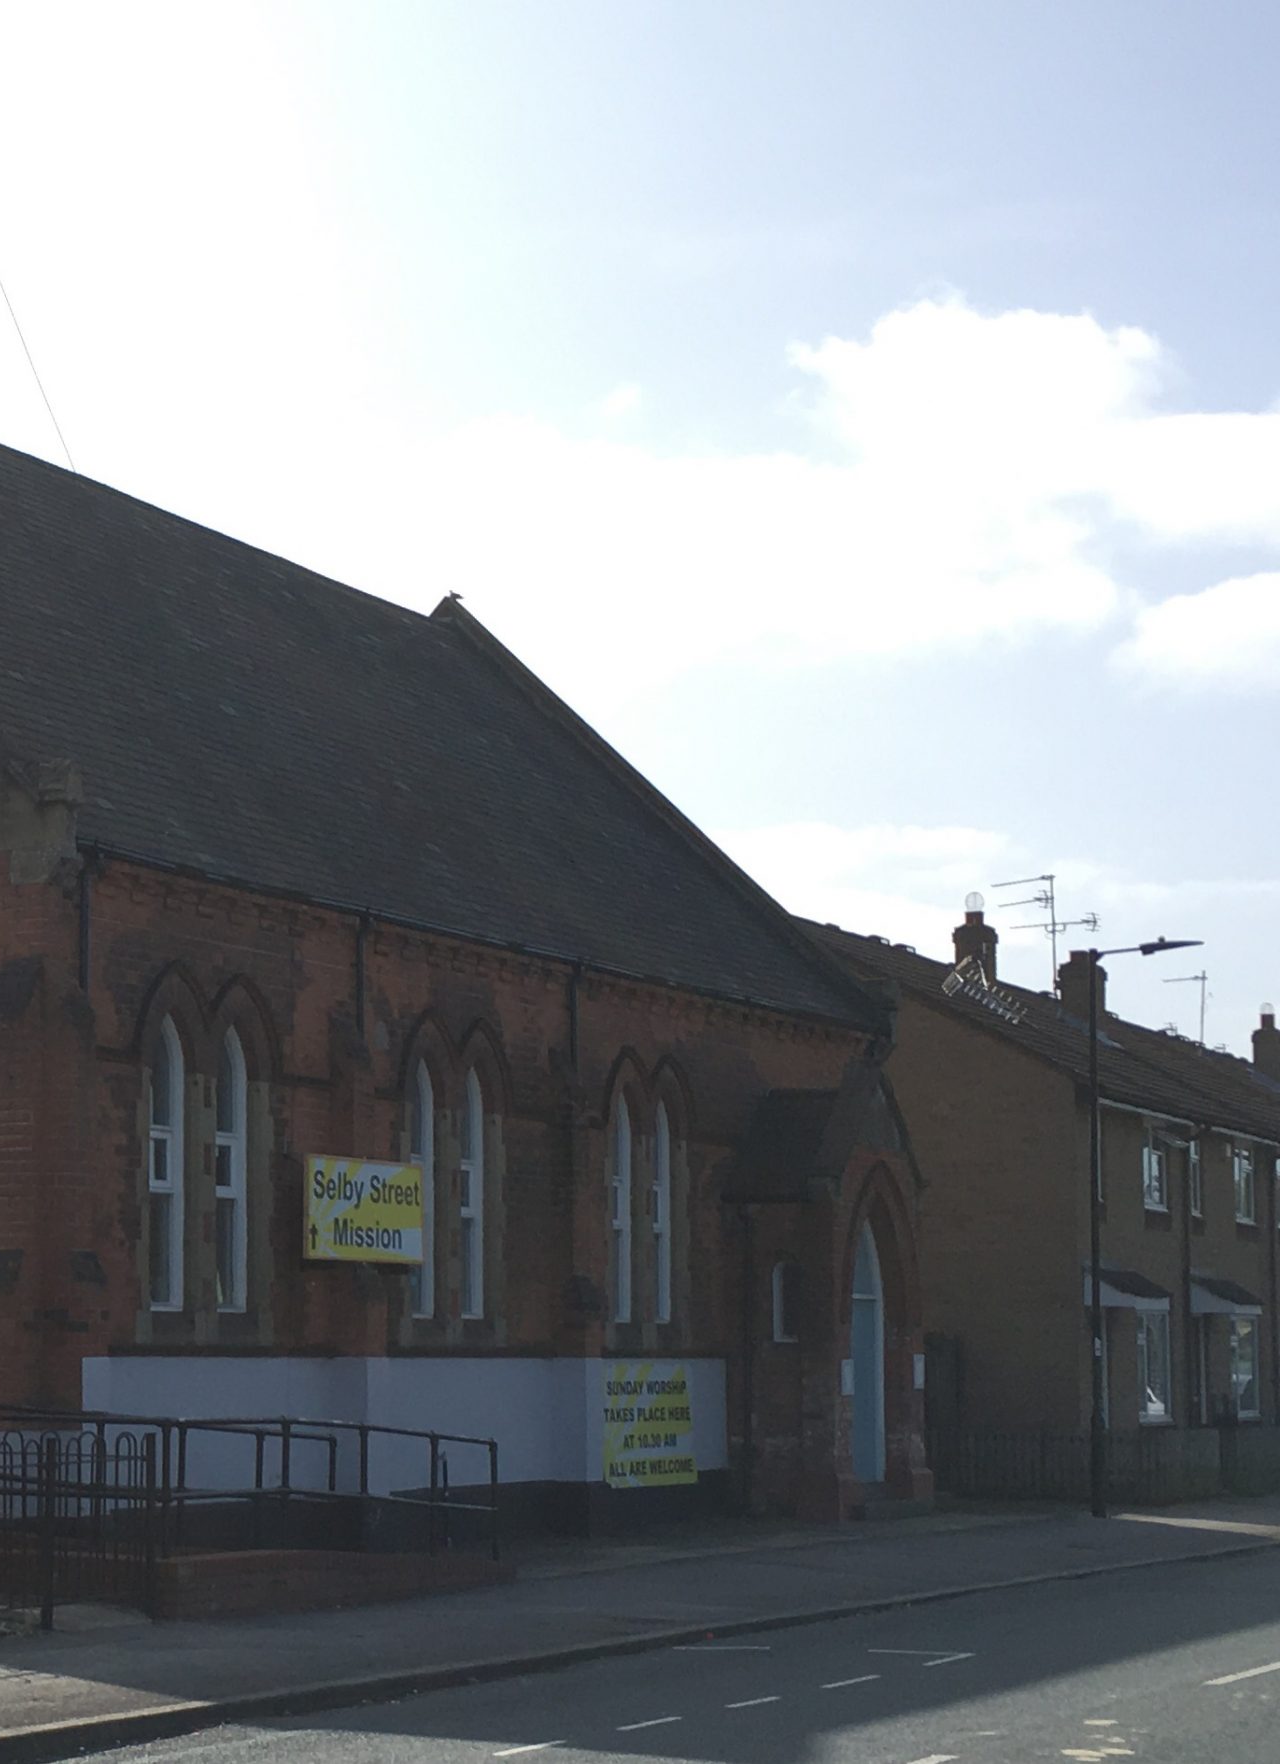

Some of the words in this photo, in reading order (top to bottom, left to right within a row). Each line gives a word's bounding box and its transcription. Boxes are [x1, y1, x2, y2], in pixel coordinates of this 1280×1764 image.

[314, 1169, 364, 1210] Selby
[370, 1174, 420, 1206] Street
[333, 1217, 402, 1250] Mission
[607, 1380, 644, 1396] SUNDAY
[646, 1380, 687, 1395] WORSHIP
[603, 1407, 634, 1423] TAKES
[637, 1407, 666, 1422] PLACE
[667, 1406, 691, 1421] HERE
[623, 1434, 635, 1449] AT
[638, 1433, 661, 1448] 10.30
[663, 1433, 677, 1447] AM
[609, 1461, 627, 1476] ALL
[629, 1460, 647, 1475] ARE
[649, 1458, 693, 1474] WELCOME
